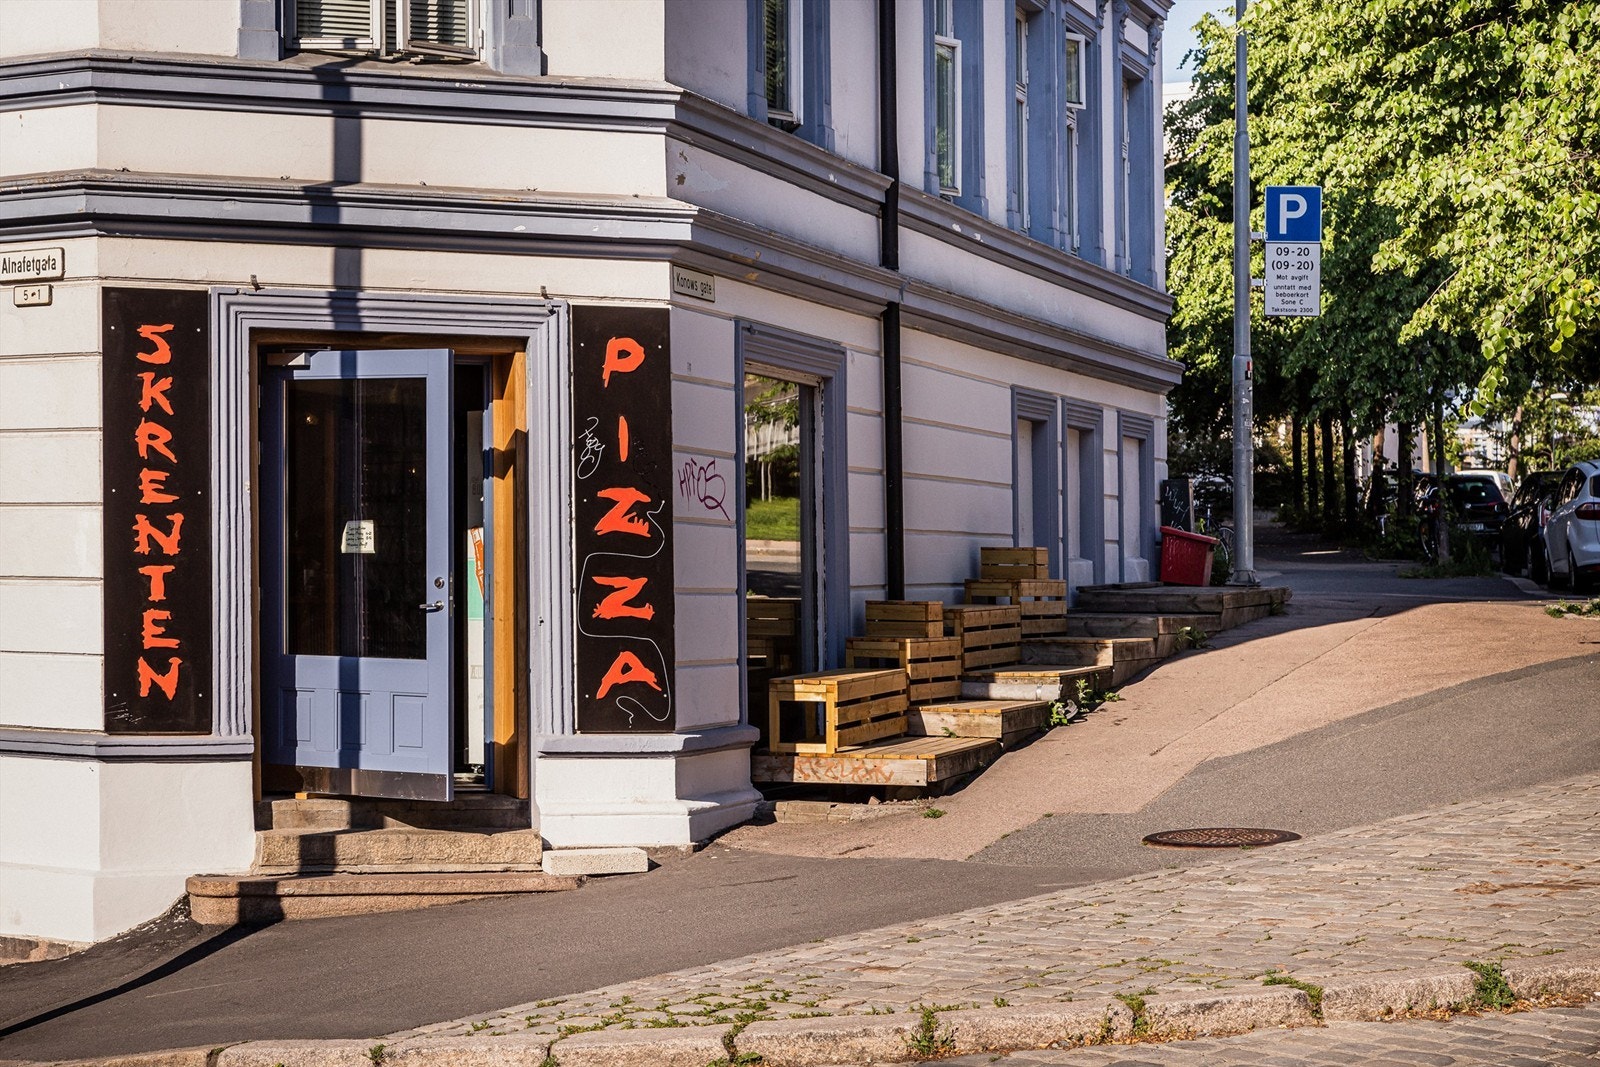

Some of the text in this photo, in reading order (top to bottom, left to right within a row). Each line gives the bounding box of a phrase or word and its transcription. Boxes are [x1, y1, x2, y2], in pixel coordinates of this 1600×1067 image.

[1279, 194, 1308, 234] P
[1, 254, 56, 275] Alnafetgata
[676, 272, 712, 296] Konows gate
[132, 322, 184, 700] SKRENTEN
[591, 337, 662, 700] PIZZA
